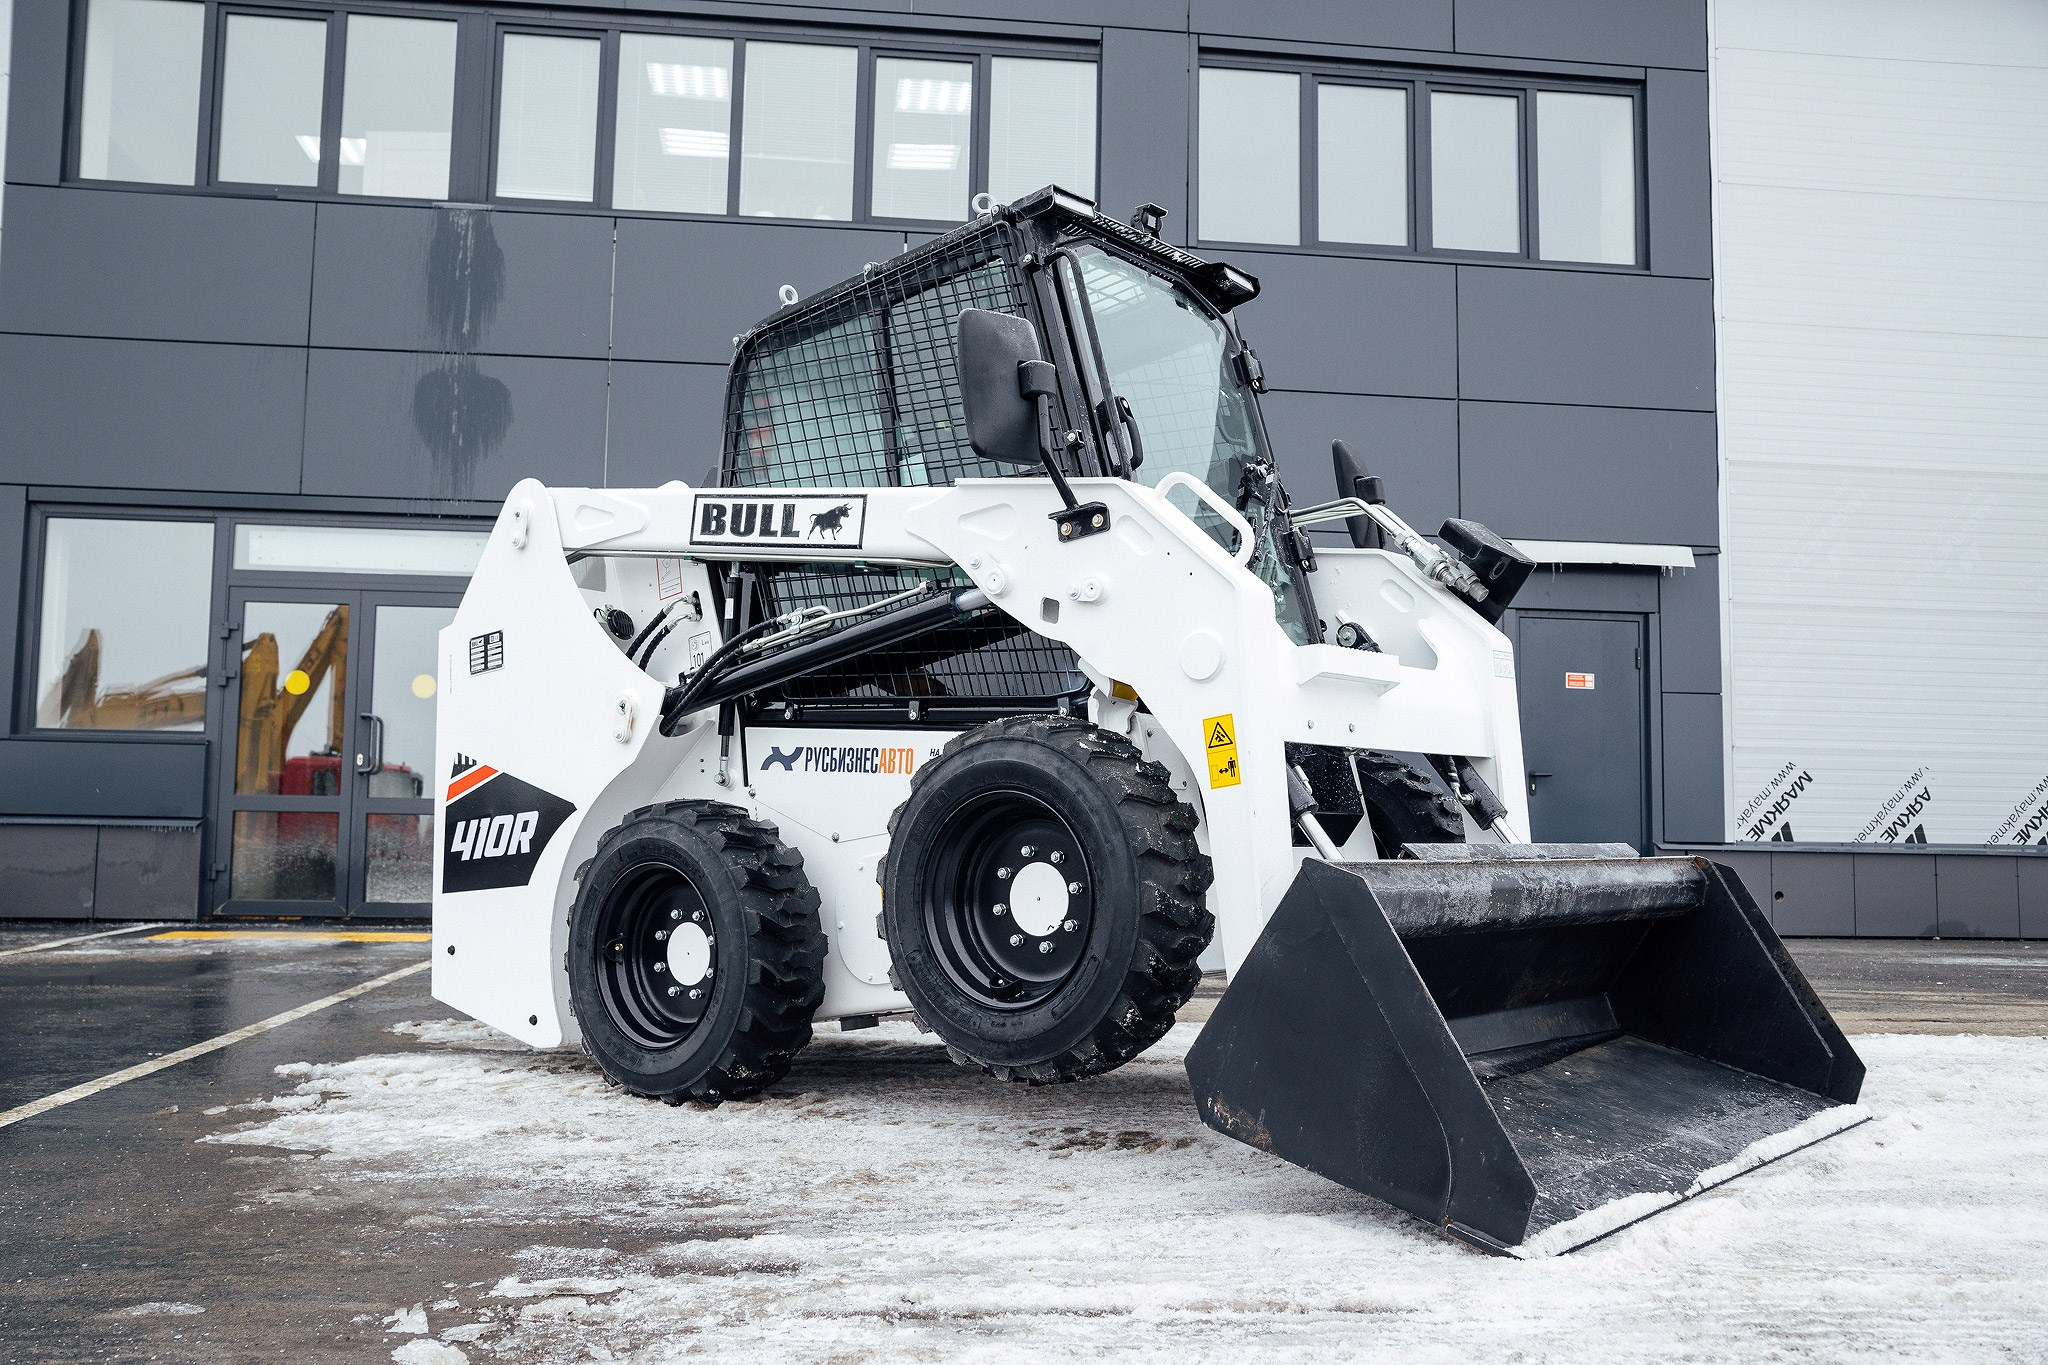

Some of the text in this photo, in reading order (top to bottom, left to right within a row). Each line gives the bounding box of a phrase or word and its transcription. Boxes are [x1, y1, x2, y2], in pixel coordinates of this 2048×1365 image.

[700, 503, 800, 538] BULL
[804, 746, 914, 775] РУСБИЗНЕСАВТО
[1741, 770, 1813, 842] МАЯКМЕ
[1878, 786, 1931, 843] АЯКМЕ
[450, 810, 539, 861] 410R
